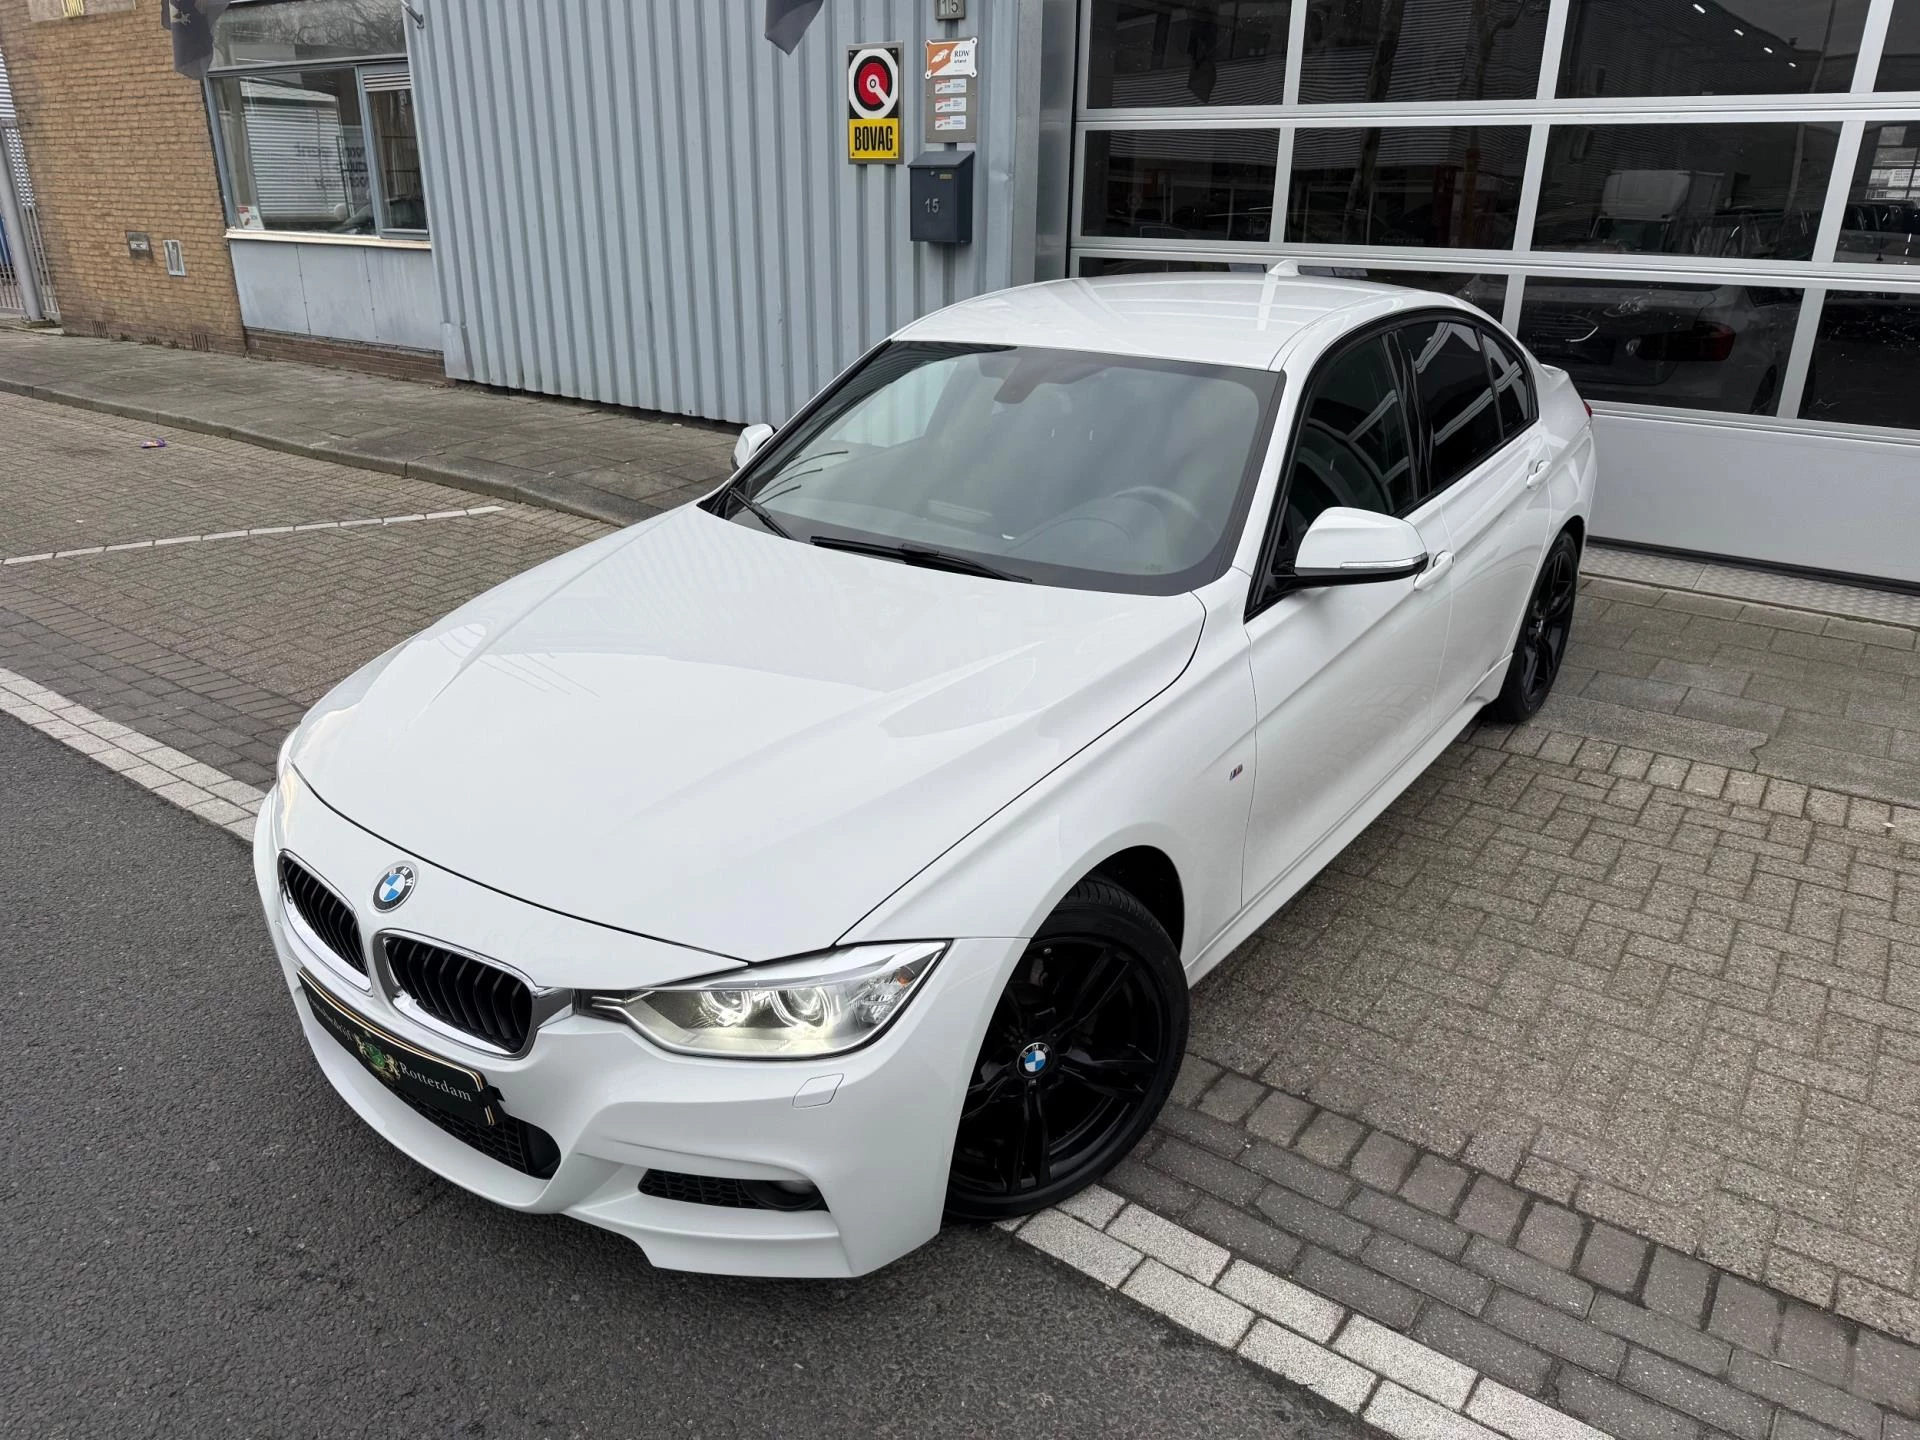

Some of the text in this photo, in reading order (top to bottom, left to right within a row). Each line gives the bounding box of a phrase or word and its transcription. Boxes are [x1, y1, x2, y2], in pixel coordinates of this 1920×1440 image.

[954, 49, 970, 57] RDW
[854, 125, 893, 152] BOVAG
[924, 198, 940, 213] 15
[1021, 1043, 1049, 1058] BMW
[399, 1061, 473, 1102] Rotterdam
